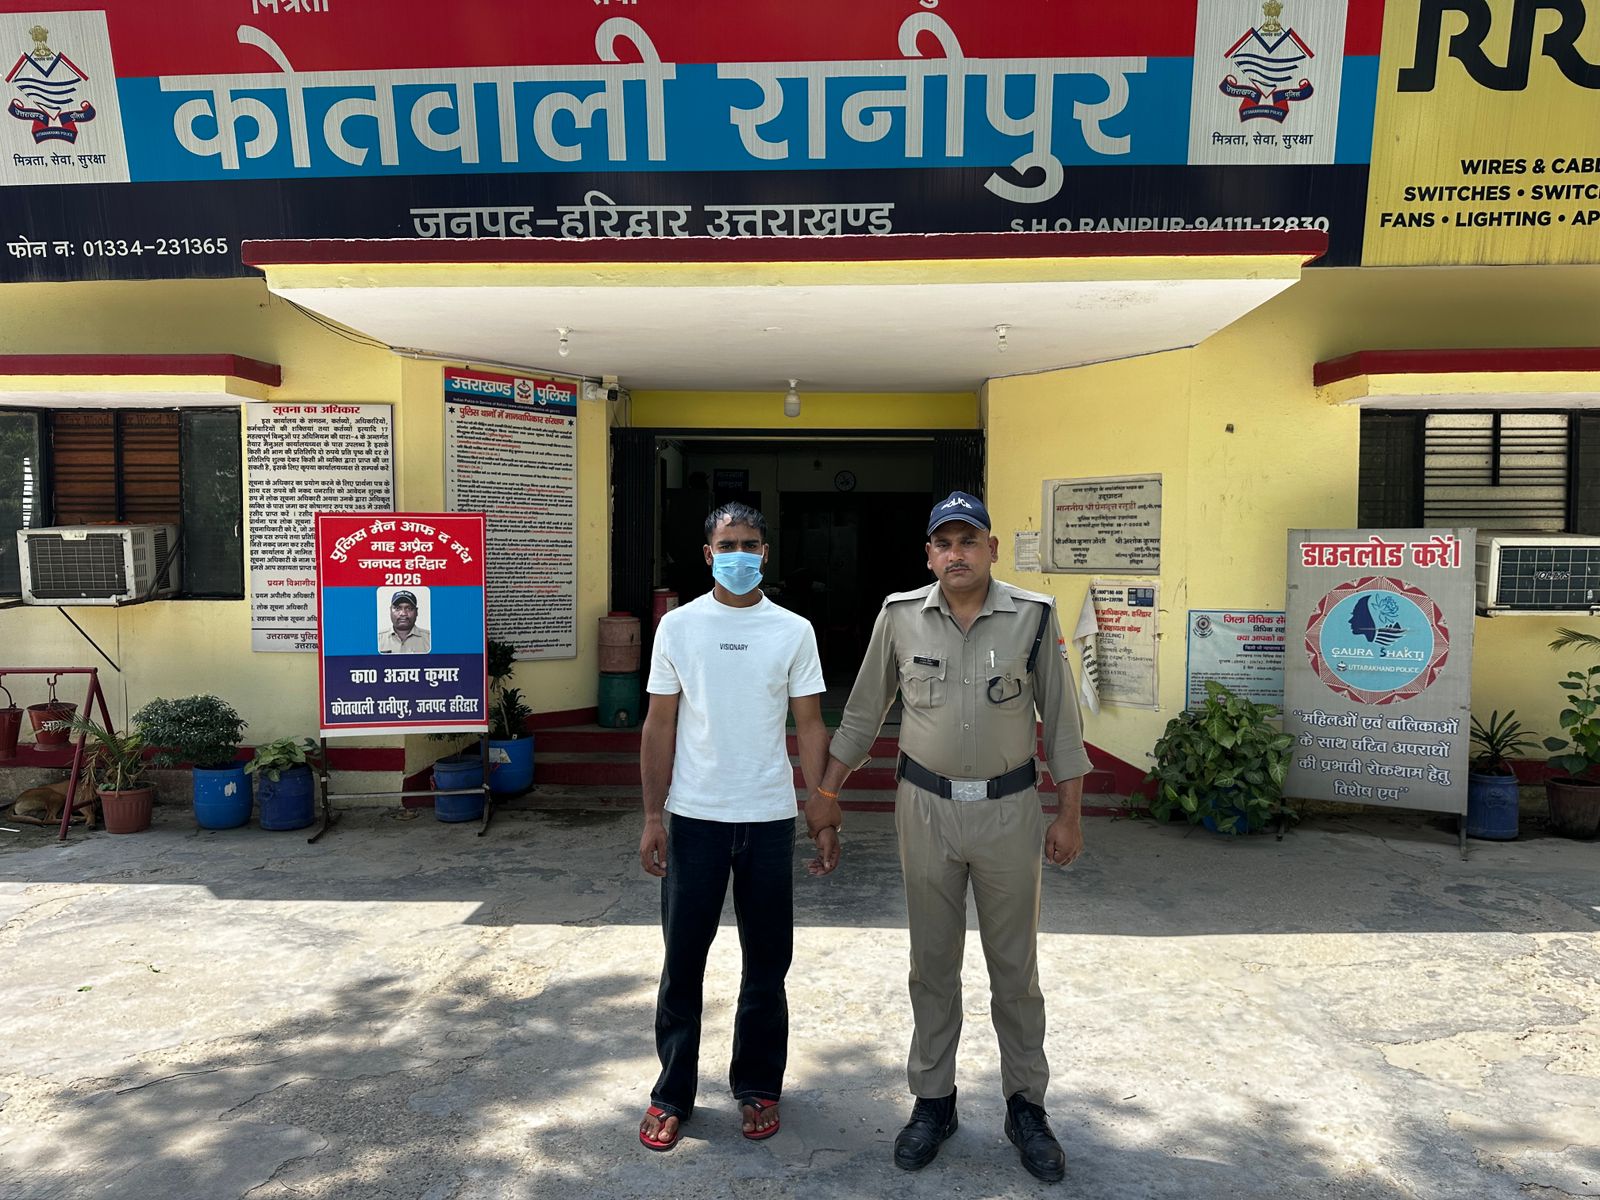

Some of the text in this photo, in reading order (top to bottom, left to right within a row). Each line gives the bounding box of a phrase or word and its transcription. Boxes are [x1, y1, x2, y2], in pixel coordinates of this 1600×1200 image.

[1284, 89, 1301, 99] पुलिस
[158, 12, 1148, 203] कोतवाली रानीपुर
[1212, 131, 1313, 149] मित्रता, सेवा, सुरक्षा
[13, 152, 106, 168] मित्रता, सेवा, सुरक्षा
[1461, 159, 1527, 175] WIRES
[1532, 158, 1546, 174] &
[1403, 184, 1600, 202] SWITCHES SWITC
[410, 190, 895, 240] जनपद-हरिद्वार उत्तराखण्ड
[1380, 213, 1435, 228] FANS
[1455, 211, 1551, 227] LIGHTING
[7, 235, 48, 259] फोन
[84, 238, 229, 258] 01334-231365
[451, 376, 512, 397] उत्तराखण्ड
[537, 384, 572, 406] पुलिस
[272, 404, 360, 416] सूचना का अधिकार
[459, 406, 480, 419] पुलिस
[330, 519, 473, 564] पुलिस मैन आफ द मंथ
[370, 537, 434, 553] माह अप्रैल
[1301, 535, 1406, 568] डाउनलोड
[357, 555, 448, 571] जनपद हरिद्वार
[385, 573, 422, 586] 2026
[1223, 614, 1245, 624] जिला
[1247, 614, 1274, 624] विधिक
[1331, 646, 1425, 659] GAURA SHAKTI
[384, 668, 421, 682] अजय
[423, 667, 460, 687] कुमार
[1348, 664, 1420, 674] UTTARAKHAND POLICE
[331, 695, 479, 719] कोतवाली रानीपुर, जनपद हरिद्वार
[1361, 713, 1384, 730] एवं
[1386, 715, 1460, 734] बालिकाओं
[1299, 731, 1451, 758] के साथ घटित अपराधों
[1298, 754, 1451, 786] की प्रभावी रोकथाम हेतु
[1333, 779, 1373, 798] विशेष
